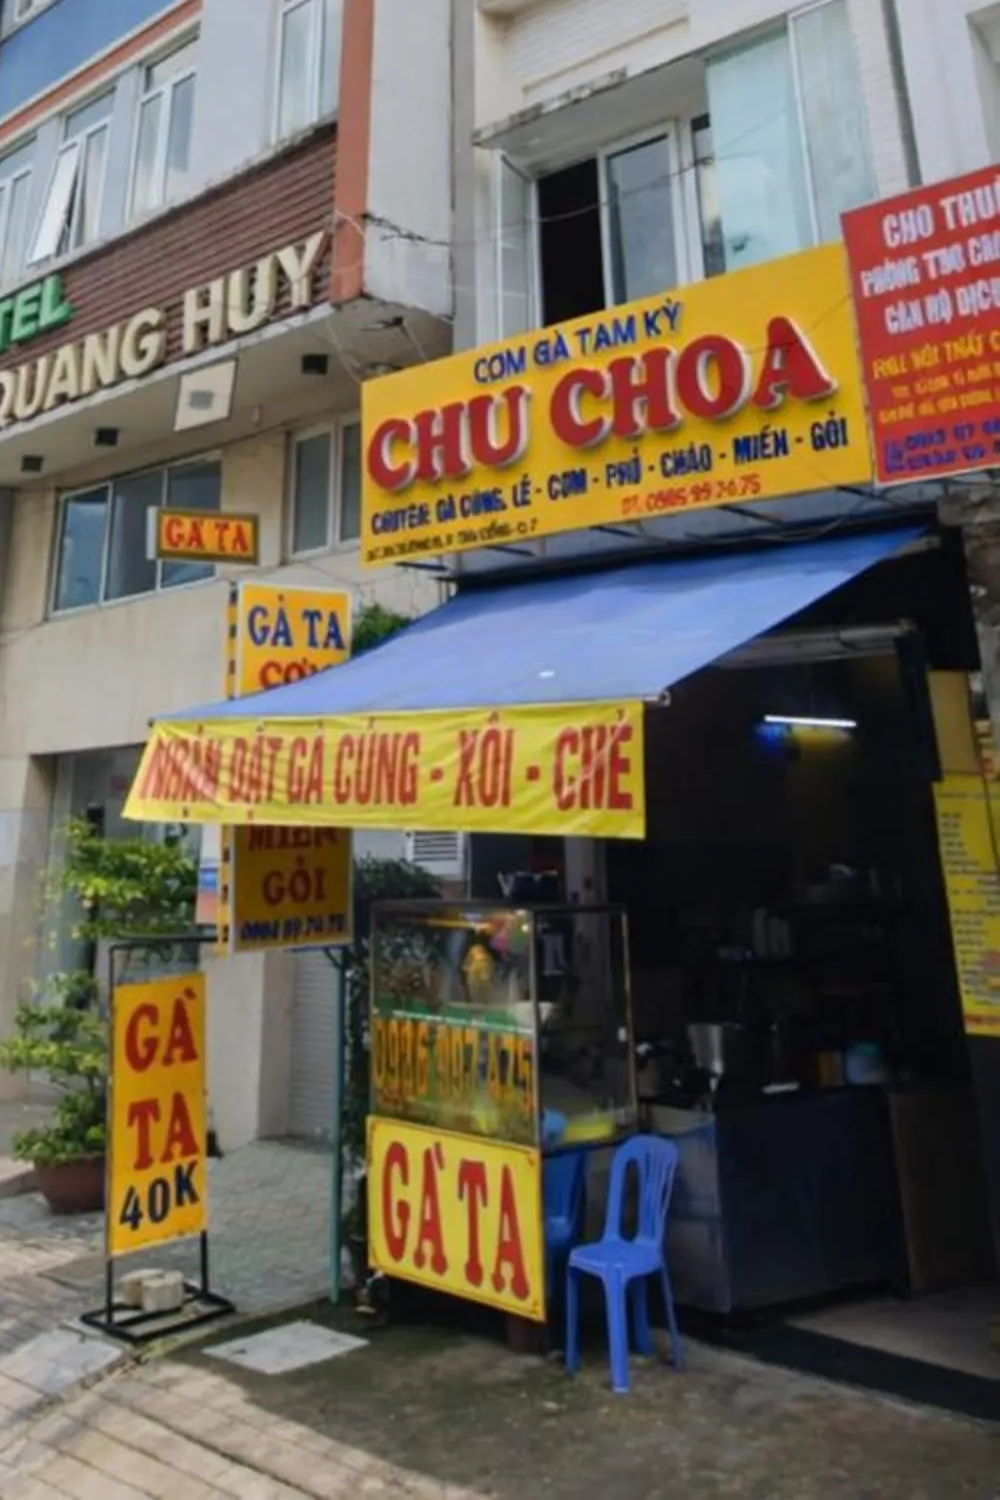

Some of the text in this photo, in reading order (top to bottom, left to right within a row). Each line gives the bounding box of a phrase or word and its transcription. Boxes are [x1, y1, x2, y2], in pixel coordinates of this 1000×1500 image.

[882, 204, 935, 249] CHO
[182, 231, 327, 354] HUY
[575, 314, 637, 356] TAM
[549, 315, 838, 449] CHOA
[214, 520, 250, 553] TA
[302, 609, 346, 651] TA
[454, 710, 515, 808] XÔI
[124, 986, 200, 1074] GÀ
[127, 1091, 200, 1172] TA
[119, 1159, 201, 1232] 40K
[382, 1139, 531, 1302] GÀ TA
